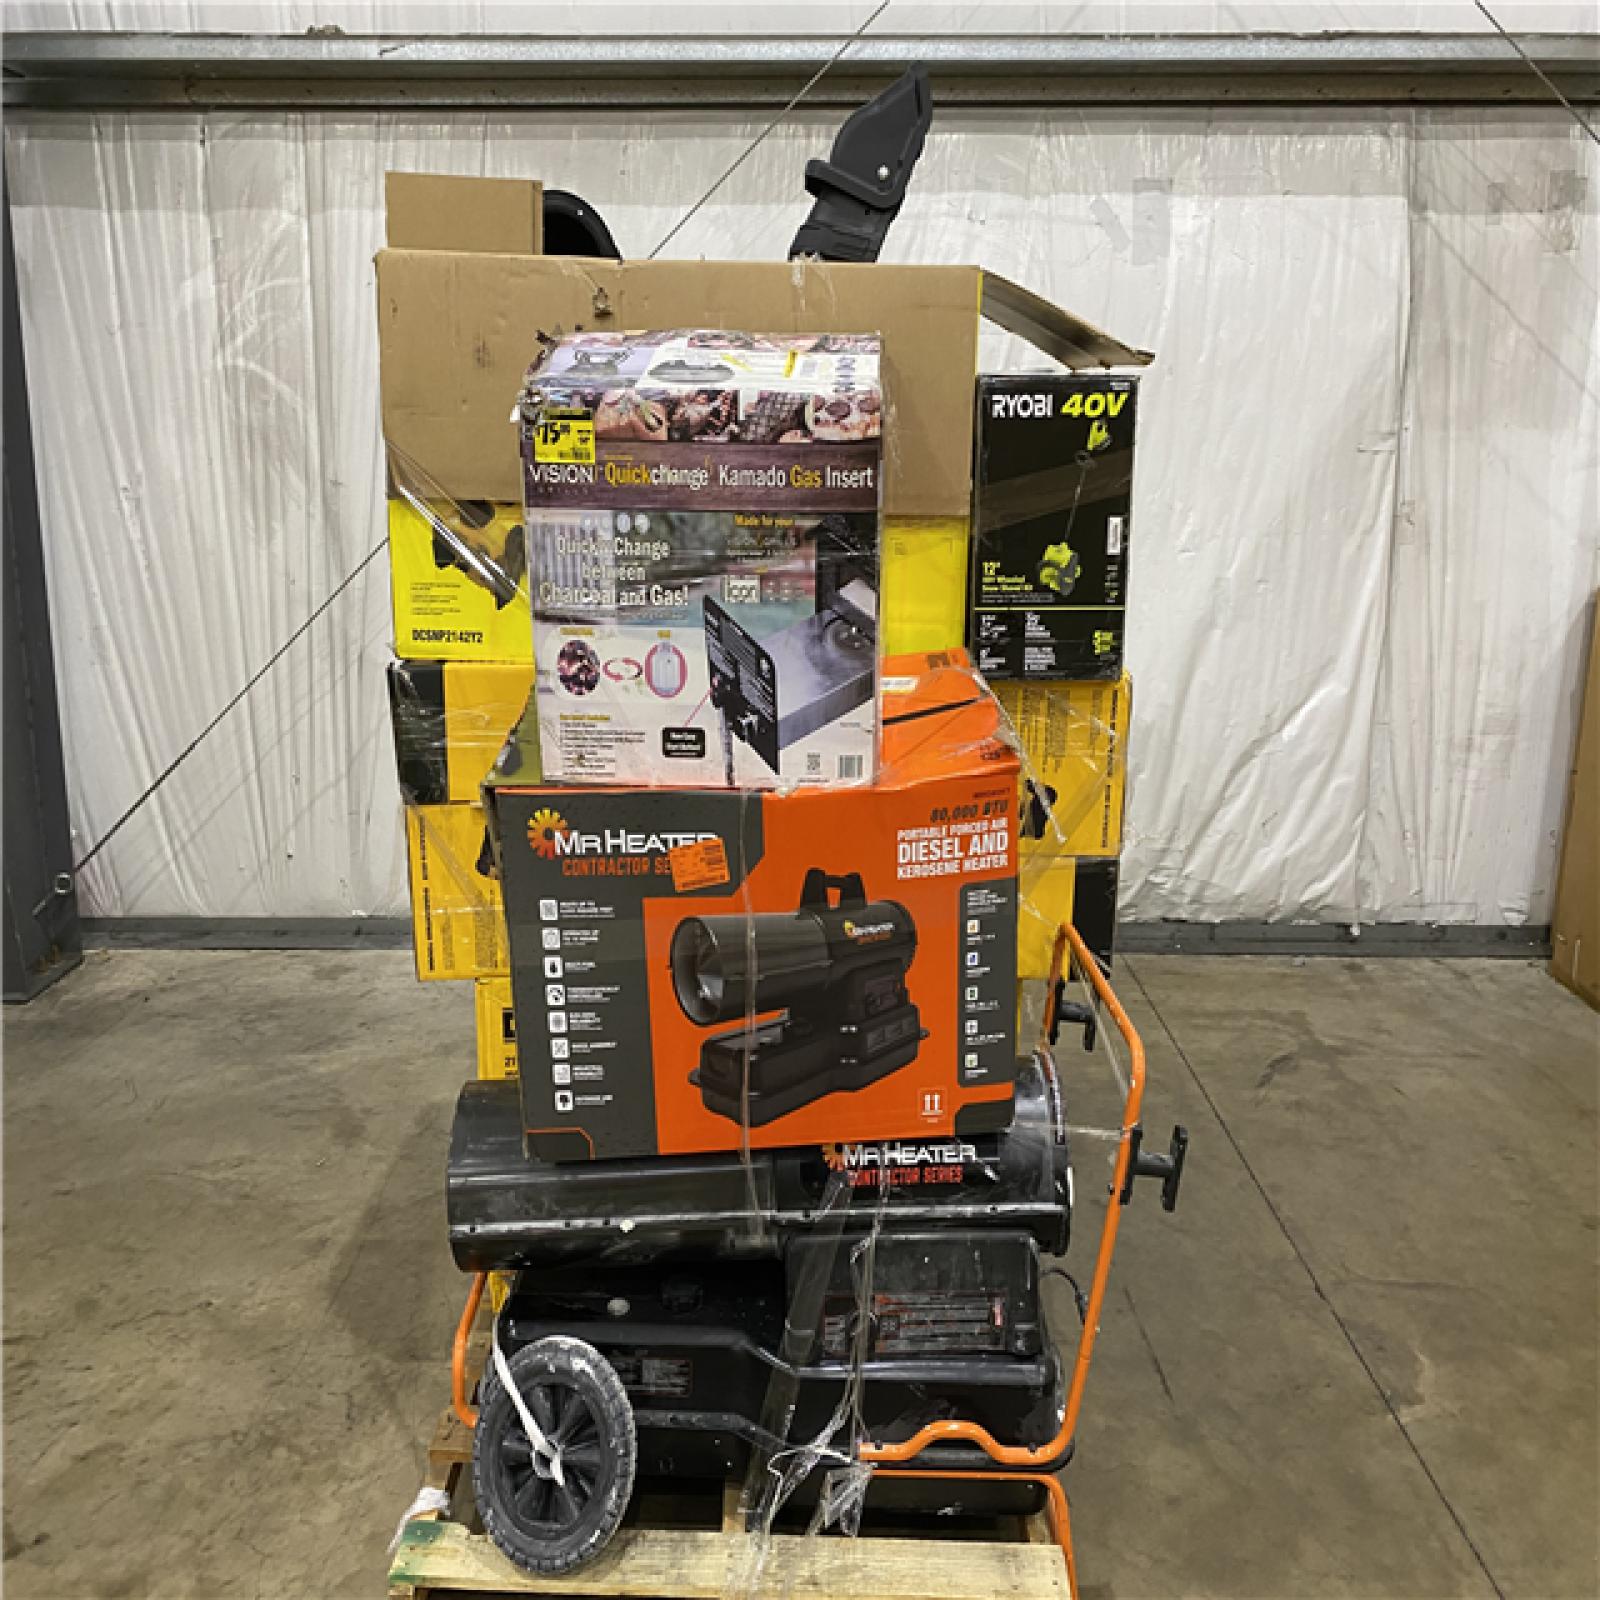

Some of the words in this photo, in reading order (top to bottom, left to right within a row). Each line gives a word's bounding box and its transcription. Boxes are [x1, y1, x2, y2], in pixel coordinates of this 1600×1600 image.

[991, 394, 1054, 418] RYOBI
[1060, 392, 1128, 418] 40V
[528, 464, 593, 483] VISION
[604, 462, 709, 491] Quickchange
[719, 465, 786, 487] Kamado
[790, 465, 822, 488] Gas
[825, 465, 873, 488] Insert
[614, 536, 671, 561] Change
[619, 585, 646, 606] and
[650, 584, 689, 606] Gas!
[897, 836, 964, 864] DIESEL
[968, 831, 1009, 856] AND
[561, 856, 650, 876] CONTRACTOR
[962, 854, 1009, 873] HEATER
[884, 1142, 977, 1165] HEATER
[924, 1164, 964, 1184] SERIES
